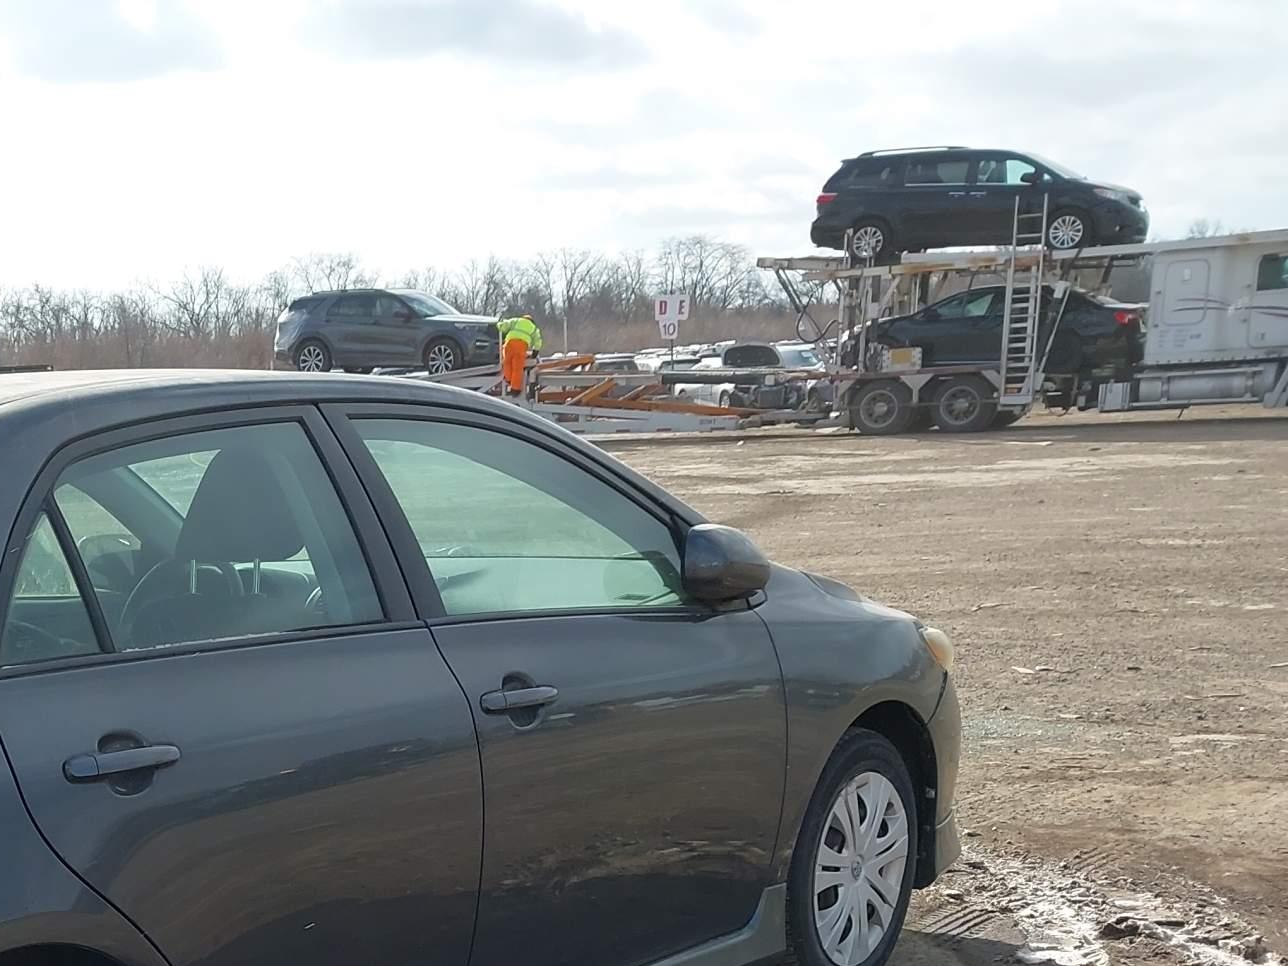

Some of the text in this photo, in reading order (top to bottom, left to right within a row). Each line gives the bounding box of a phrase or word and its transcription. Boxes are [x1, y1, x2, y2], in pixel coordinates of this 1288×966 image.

[659, 300, 685, 315] D E
[663, 323, 676, 336] 10
